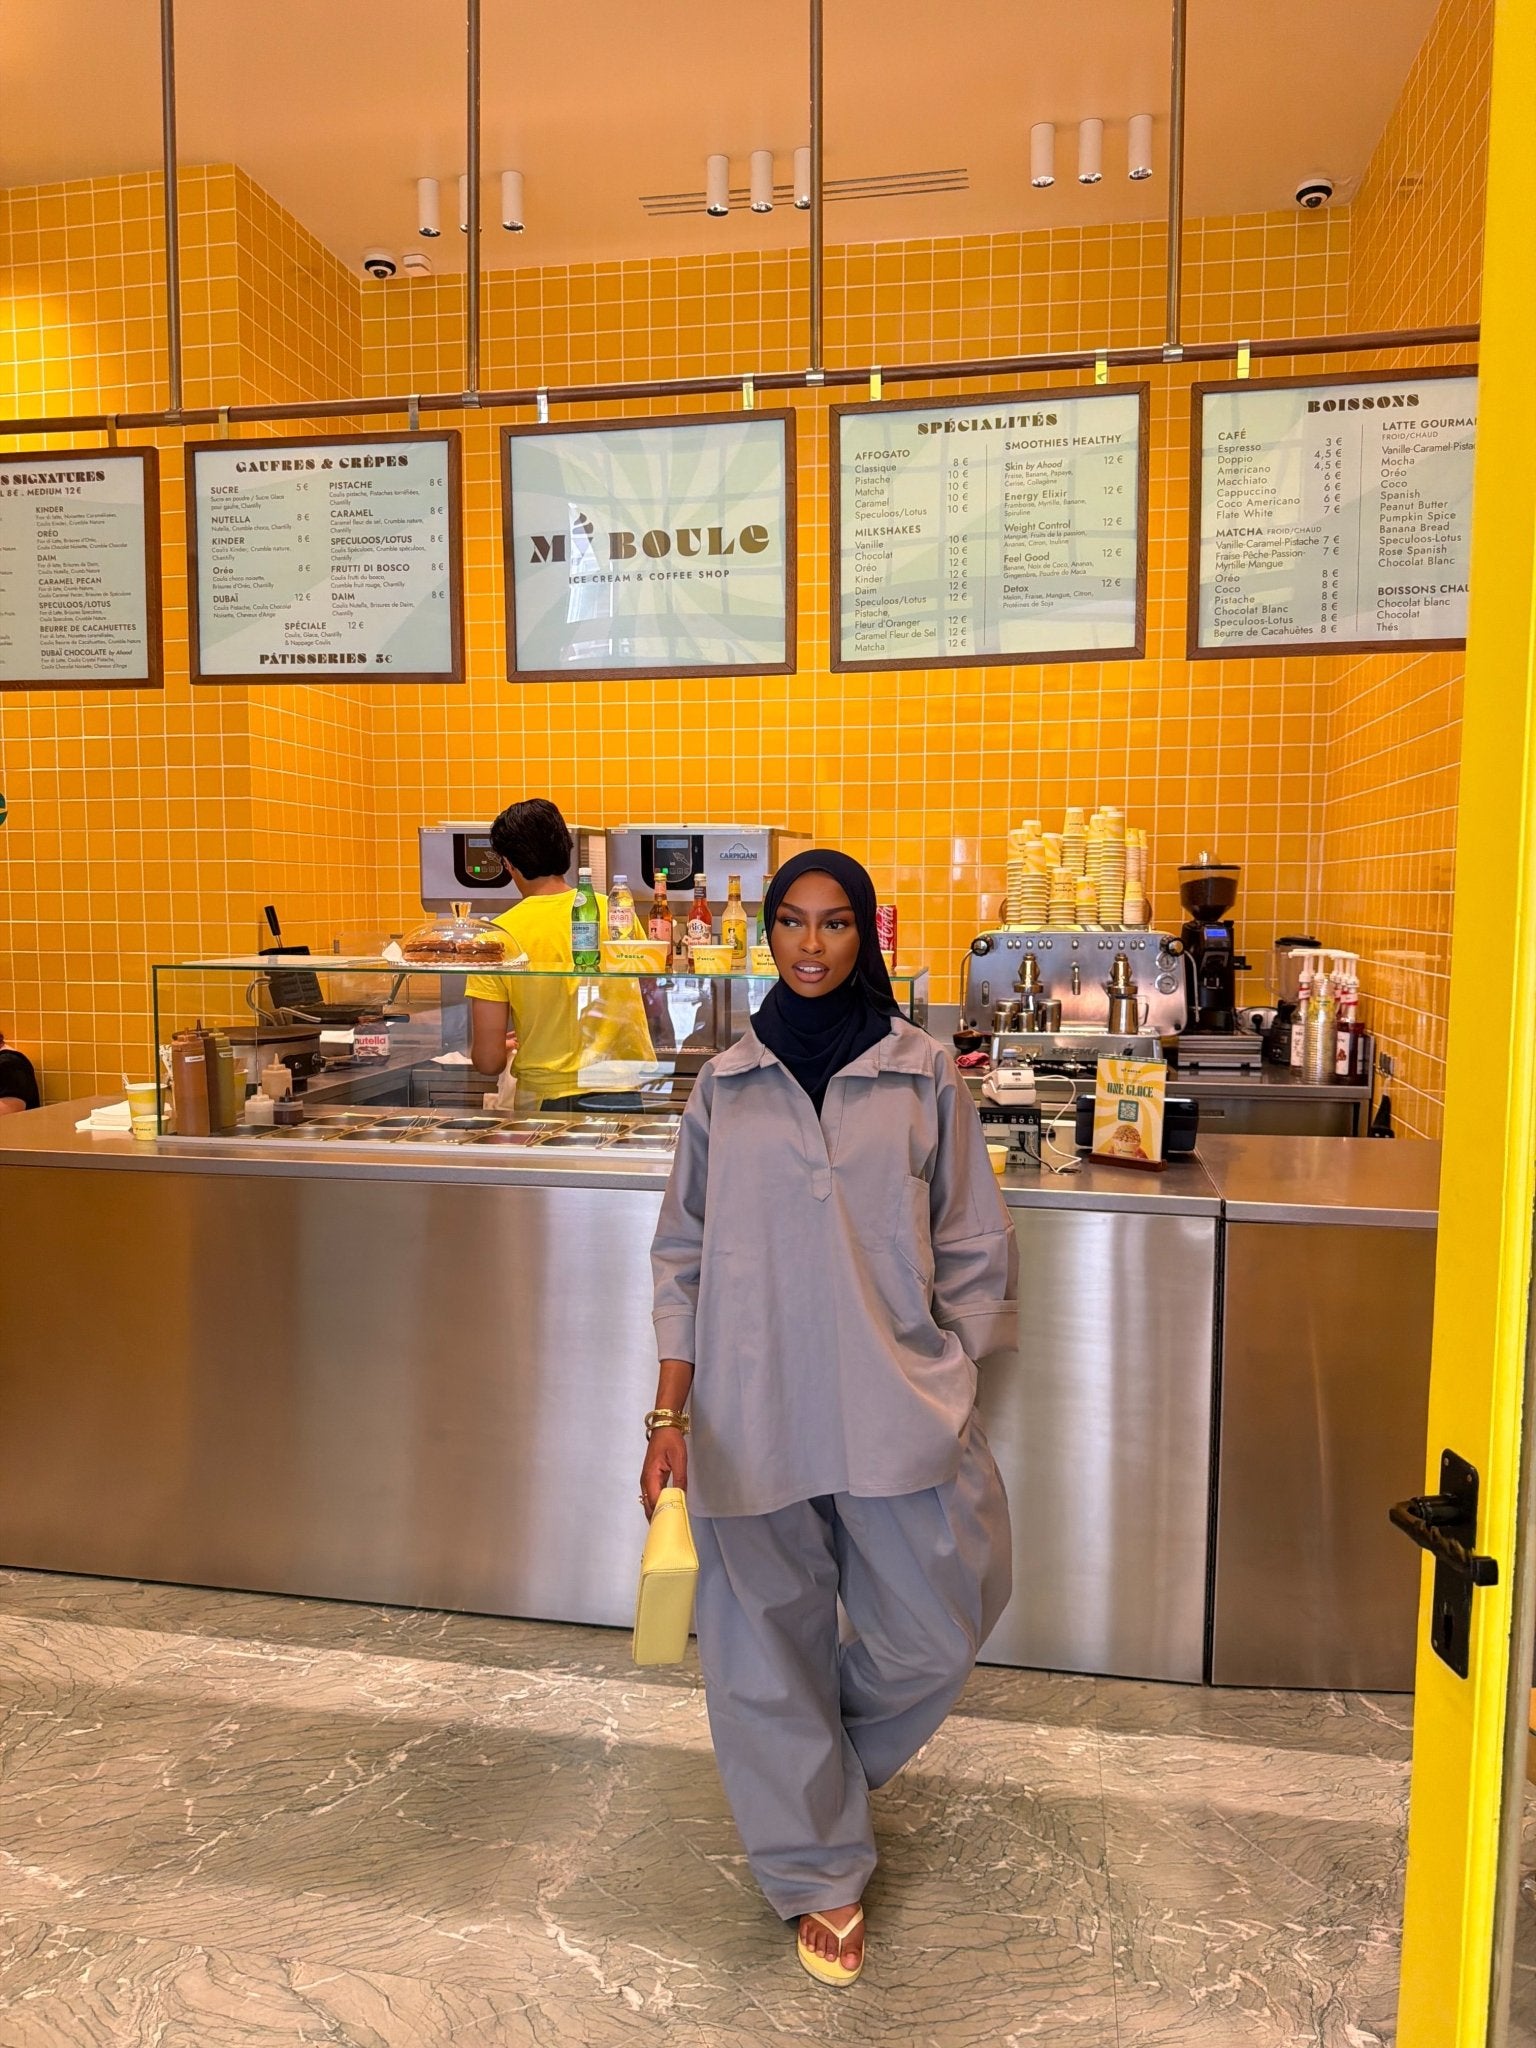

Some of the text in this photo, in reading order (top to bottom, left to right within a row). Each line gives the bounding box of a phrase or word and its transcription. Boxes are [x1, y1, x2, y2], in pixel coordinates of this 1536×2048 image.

[1308, 394, 1419, 413] BOISSONS
[918, 412, 1057, 435] SPÉCIALITÉS
[1383, 417, 1477, 430] LATTE GOURMA
[1218, 429, 1246, 440] CAFÉ
[1382, 431, 1438, 440] FROID/CHAUD
[1005, 434, 1121, 450] SMOOTHIES HEALTHY
[1218, 444, 1261, 454] Espresso
[1382, 441, 1475, 455] Vanille-Caramel-Pista
[855, 450, 910, 460] AFFOGATO
[236, 454, 408, 473] GAUFRES & CRÊPES
[1005, 460, 1062, 471] Skin by Ahood
[1218, 456, 1253, 465] Doppio
[1382, 457, 1415, 466] Mocha
[855, 464, 896, 474] Classique
[1217, 466, 1270, 475] Americano
[1381, 468, 1407, 477] Oréo
[13, 471, 105, 484] SIGNATURES
[855, 476, 890, 485] Pistache
[1217, 476, 1267, 485] Macchiato
[330, 481, 372, 489] PISTACHE
[1381, 479, 1407, 488] Coco
[211, 486, 238, 494] SUCRE
[855, 488, 884, 496] Matcha
[1217, 487, 1276, 497] Cappuccino
[1381, 490, 1420, 500] Spanish
[1005, 490, 1067, 501] Energy Elixir
[855, 499, 889, 508] Caramel
[1217, 497, 1300, 508] Coco Americano
[1380, 501, 1448, 510] Peanut Butter
[331, 509, 373, 518] CARAMEL
[855, 508, 927, 520] Speculoos/Lotus
[1217, 509, 1273, 519] Flate White
[1380, 511, 1456, 522] Pumpkin Spice
[211, 516, 250, 524] NUTELLA
[855, 525, 921, 537] MILKSHAKES
[1004, 521, 1070, 533] Weight Control
[1216, 526, 1321, 537] MATCHA FROID/CHAUD
[1379, 522, 1449, 533] Banana Bread
[212, 536, 245, 545] KINDER
[331, 536, 412, 545] SPECULOOS/LOTUS
[1216, 537, 1319, 549] Vanille-Caramel-Pistache
[1379, 534, 1461, 544] Speculoos-Lotus
[855, 541, 883, 549] Vanille
[1379, 545, 1446, 556] Rose Spanish
[855, 552, 893, 560] Chocolat
[1004, 553, 1049, 563] Feel Good
[1215, 560, 1283, 570] Myrtille-Mangue
[1378, 556, 1455, 567] Chocolat Blanc
[213, 566, 233, 574] Oréo
[331, 563, 410, 573] FRUTTI DI BOSCO
[855, 564, 876, 572] Oréo
[593, 575, 630, 583] CREAM
[650, 572, 692, 580] COFFEE
[699, 570, 729, 578] SHOP
[855, 575, 883, 583] Kinder
[1215, 574, 1240, 582] Oréo
[855, 587, 877, 595] Daim
[1004, 584, 1029, 593] Detox
[1215, 585, 1240, 594] Coco
[1378, 585, 1436, 595] BOISSONS
[213, 594, 238, 603] DUBAÏ
[332, 593, 355, 601] DAIM
[855, 596, 926, 607] Speculoos/Lotus
[1215, 596, 1255, 604] Pistache
[1377, 597, 1450, 607] Chocolat blanc
[39, 601, 111, 609] SPECULOOS/LOTUS
[1214, 605, 1288, 615] Chocolat Blanc
[1377, 610, 1420, 619] Chocolat
[285, 620, 327, 630] SPÉCIALE
[878, 619, 920, 629] d'Oranger
[1214, 616, 1293, 627] Speculoos-Lotus
[1377, 622, 1398, 631] Thés
[82, 623, 136, 631] CACAHUETTES
[1214, 626, 1313, 637] Beurre de Cacahuètes
[855, 629, 936, 640] Caramel Fleur de Sel
[41, 648, 62, 656] DUBAÏ
[855, 643, 885, 651] Matcha
[355, 1036, 385, 1045] nutella
